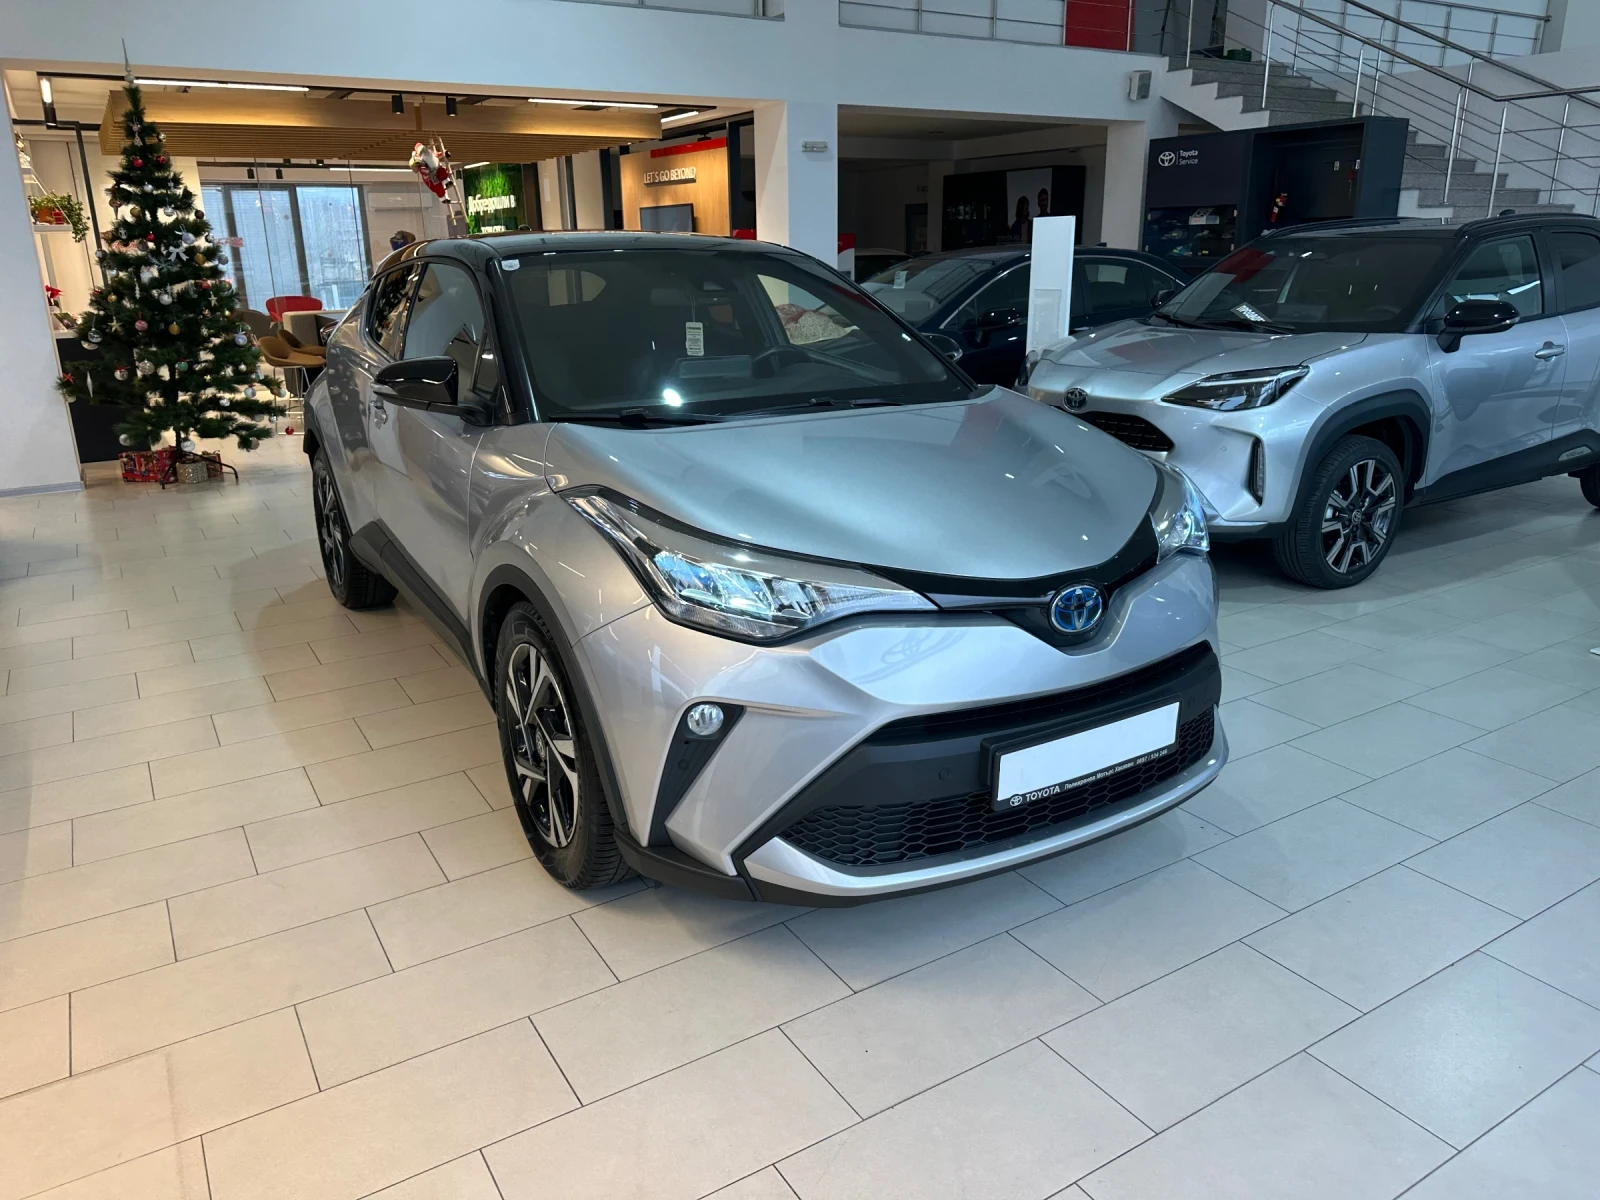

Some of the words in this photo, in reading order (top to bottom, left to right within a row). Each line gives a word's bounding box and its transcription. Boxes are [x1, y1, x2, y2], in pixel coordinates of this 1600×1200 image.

[1179, 149, 1199, 158] Toyota
[1179, 158, 1199, 166] Service
[643, 170, 660, 184] LET'S
[660, 169, 670, 182] GO
[670, 166, 696, 181] BEYOND
[468, 193, 509, 216] Добредошли
[1025, 785, 1060, 802] TOYOTA
